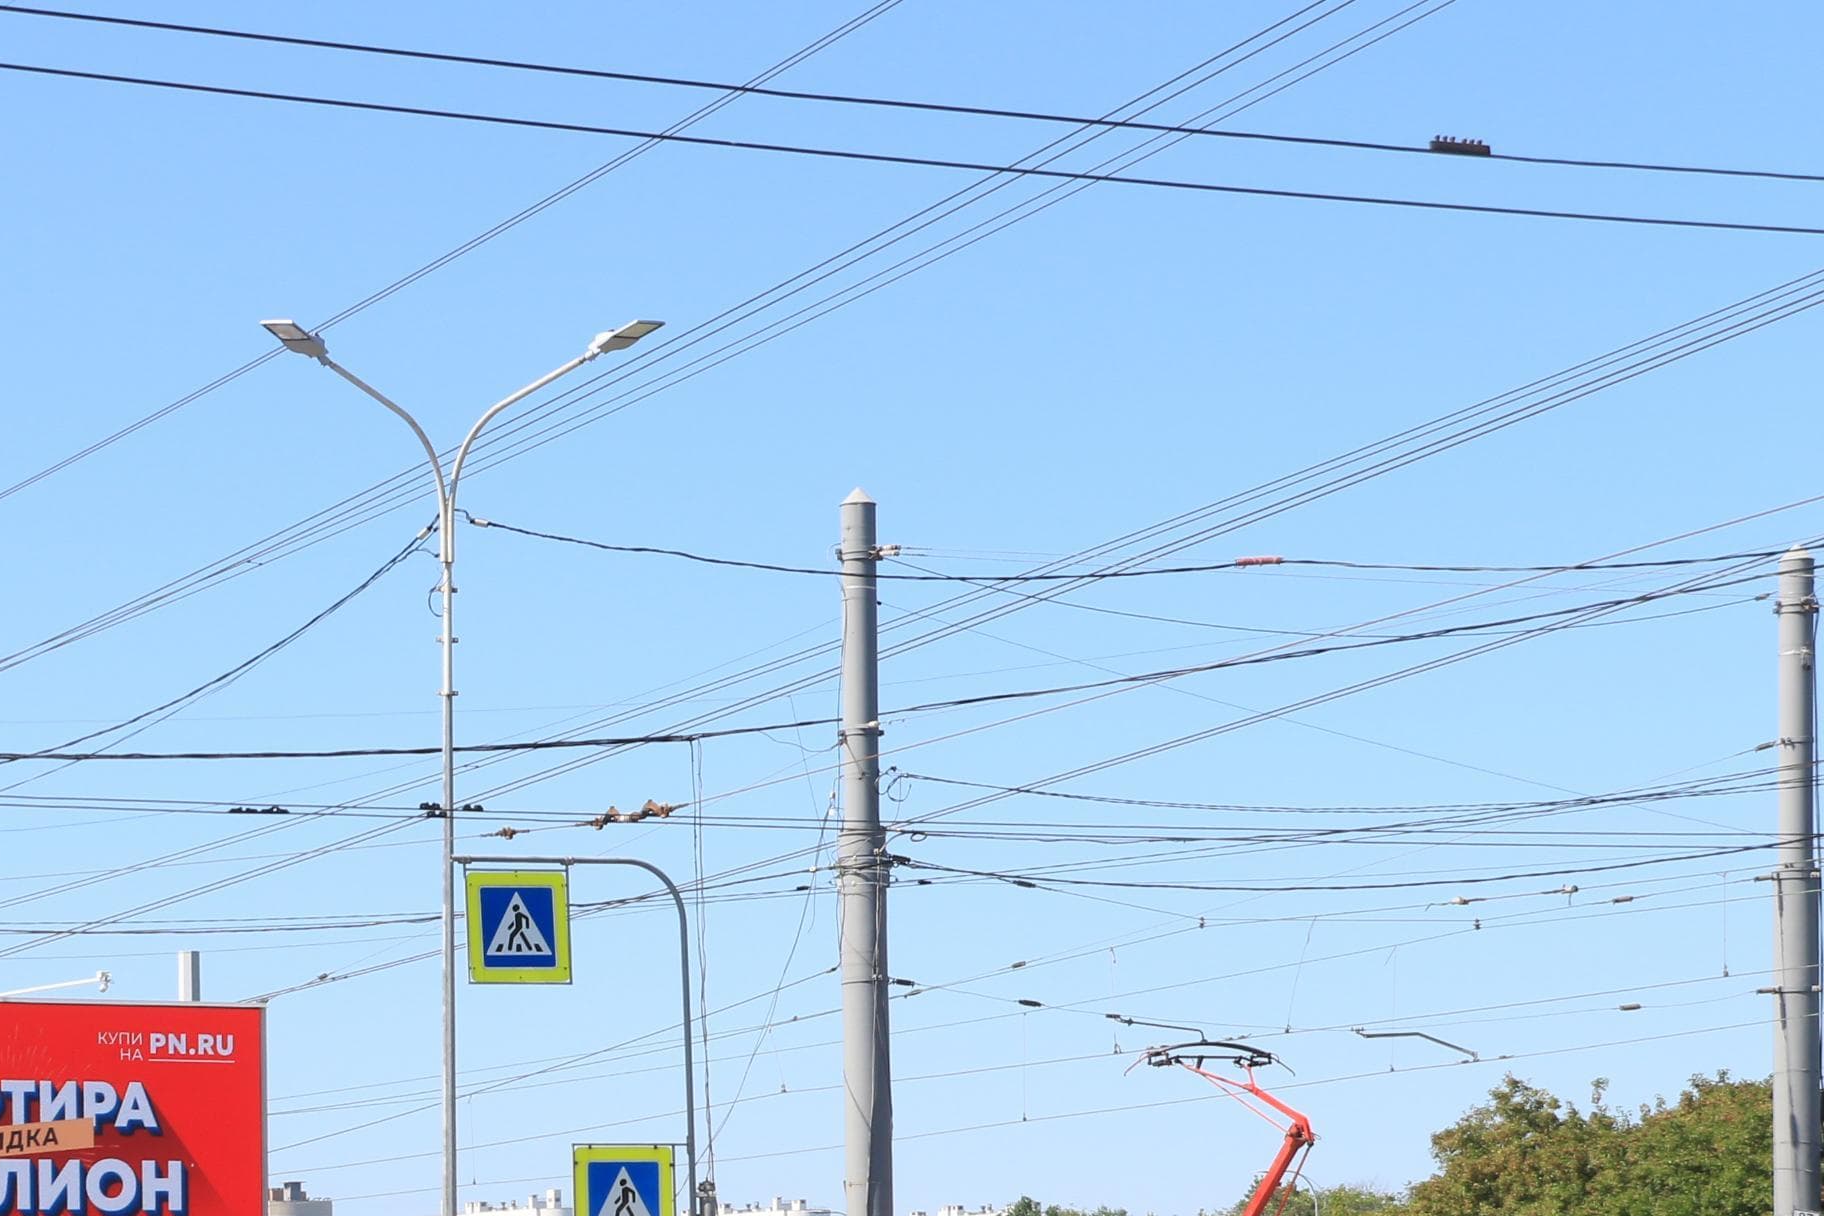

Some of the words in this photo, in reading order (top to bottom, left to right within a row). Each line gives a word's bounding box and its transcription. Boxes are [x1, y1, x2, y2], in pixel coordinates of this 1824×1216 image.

[98, 1032, 143, 1045] КУПИ
[149, 1032, 234, 1056] PN.RU
[120, 1048, 144, 1061] НА
